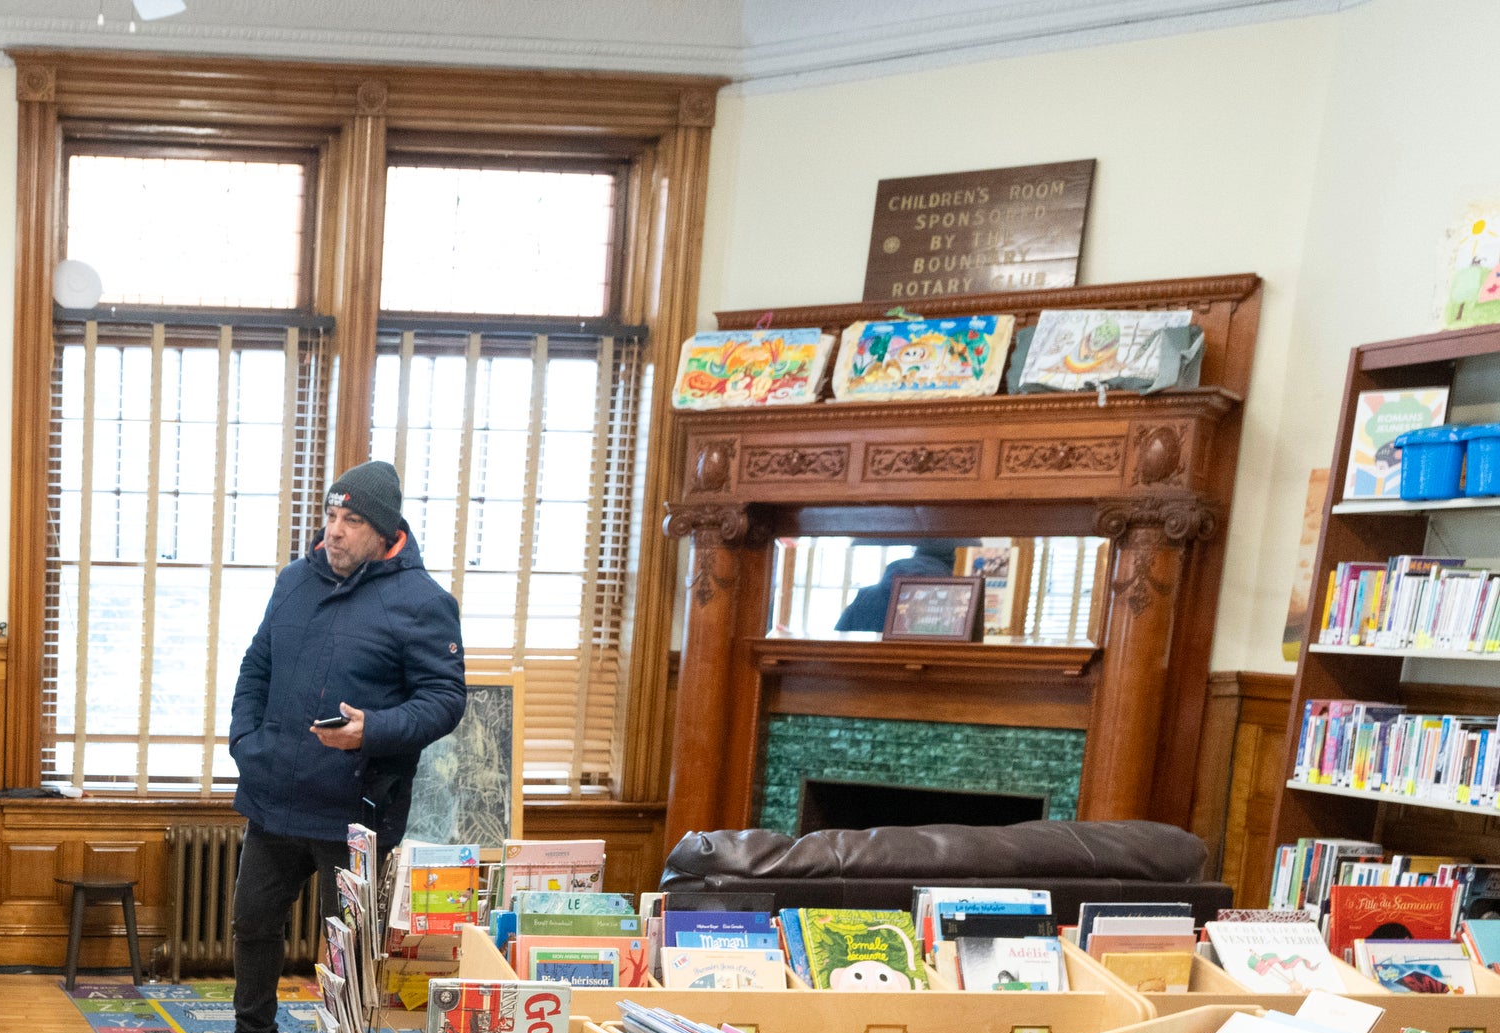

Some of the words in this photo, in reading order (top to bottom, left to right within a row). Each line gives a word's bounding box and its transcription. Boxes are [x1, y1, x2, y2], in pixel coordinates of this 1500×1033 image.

[888, 186, 990, 212] CHILDREN'S
[1009, 180, 1066, 200] ROOM
[930, 234, 957, 250] BY
[971, 230, 1014, 248] THE
[912, 249, 1031, 274] BOUNDARY
[891, 278, 973, 298] ROTARY
[991, 271, 1047, 289] CLUB
[1377, 411, 1424, 424] ROMANS
[567, 898, 581, 910] LE
[699, 934, 749, 949] Maman!
[1008, 946, 1050, 958] Adélie
[571, 975, 609, 986] hérisson
